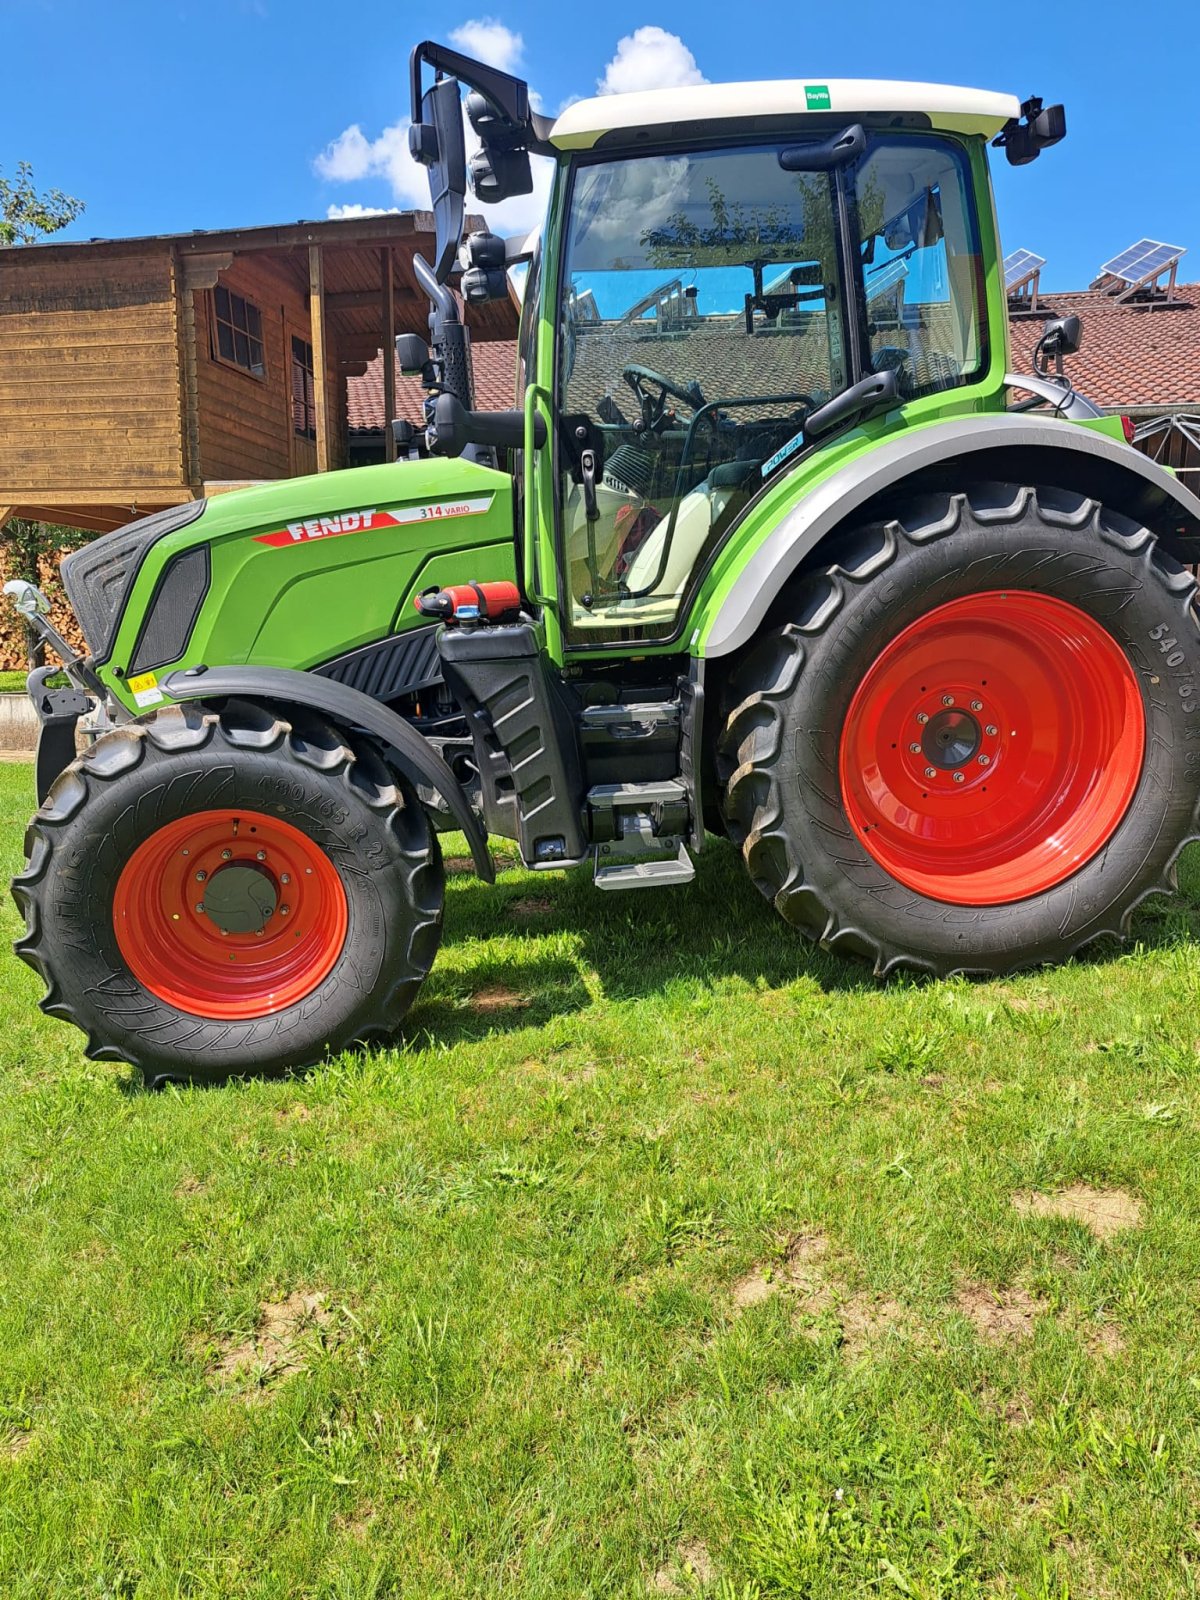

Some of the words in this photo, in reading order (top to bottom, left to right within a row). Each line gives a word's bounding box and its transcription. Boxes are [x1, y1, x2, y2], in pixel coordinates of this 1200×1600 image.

[420, 504, 443, 519] 314
[444, 504, 470, 515] VARIO
[286, 508, 377, 541] FENDT
